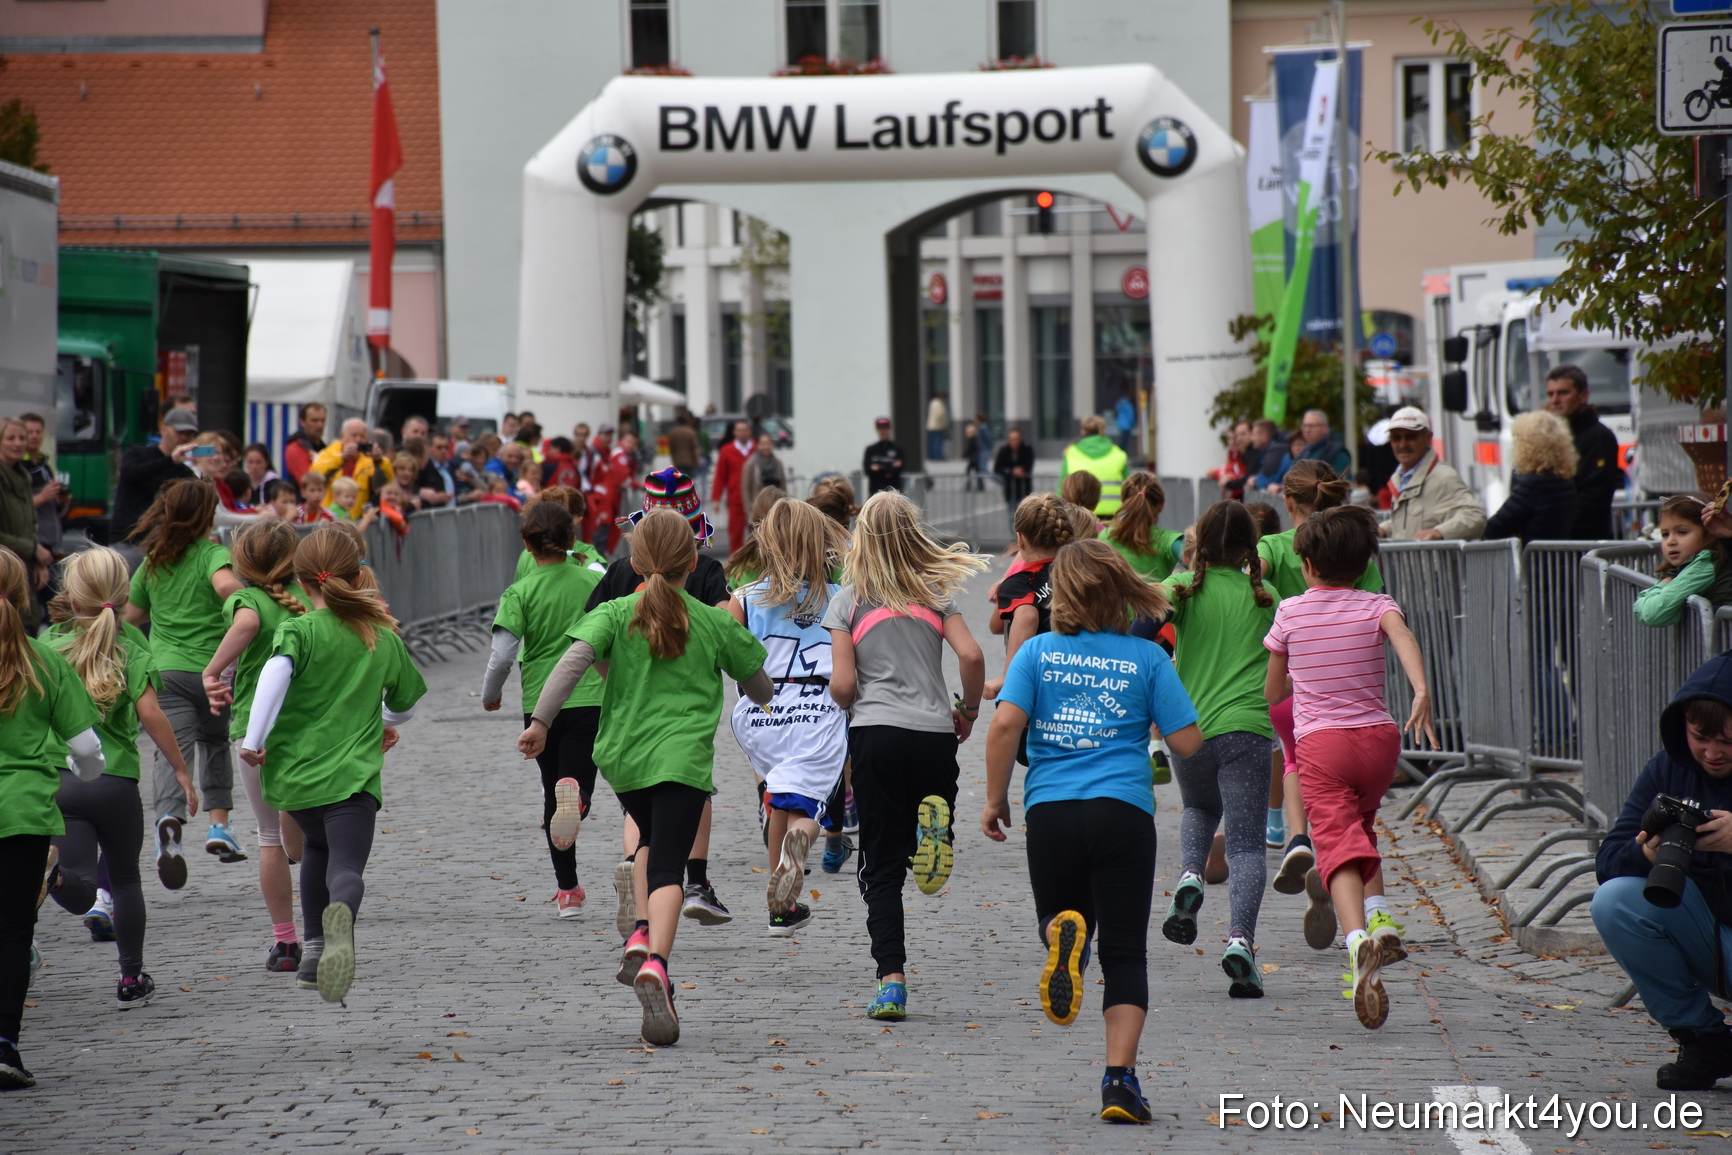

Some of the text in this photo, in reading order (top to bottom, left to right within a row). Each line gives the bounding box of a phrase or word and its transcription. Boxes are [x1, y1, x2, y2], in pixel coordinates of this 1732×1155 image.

[659, 97, 1115, 156] BMW Laufsport
[1040, 651, 1138, 675] NEUMARKTER
[1042, 670, 1130, 692] STADTLAUF
[1097, 691, 1127, 718] 2014
[750, 715, 821, 728] NEUMARKT
[1035, 719, 1118, 738] BAMBINI LAUF
